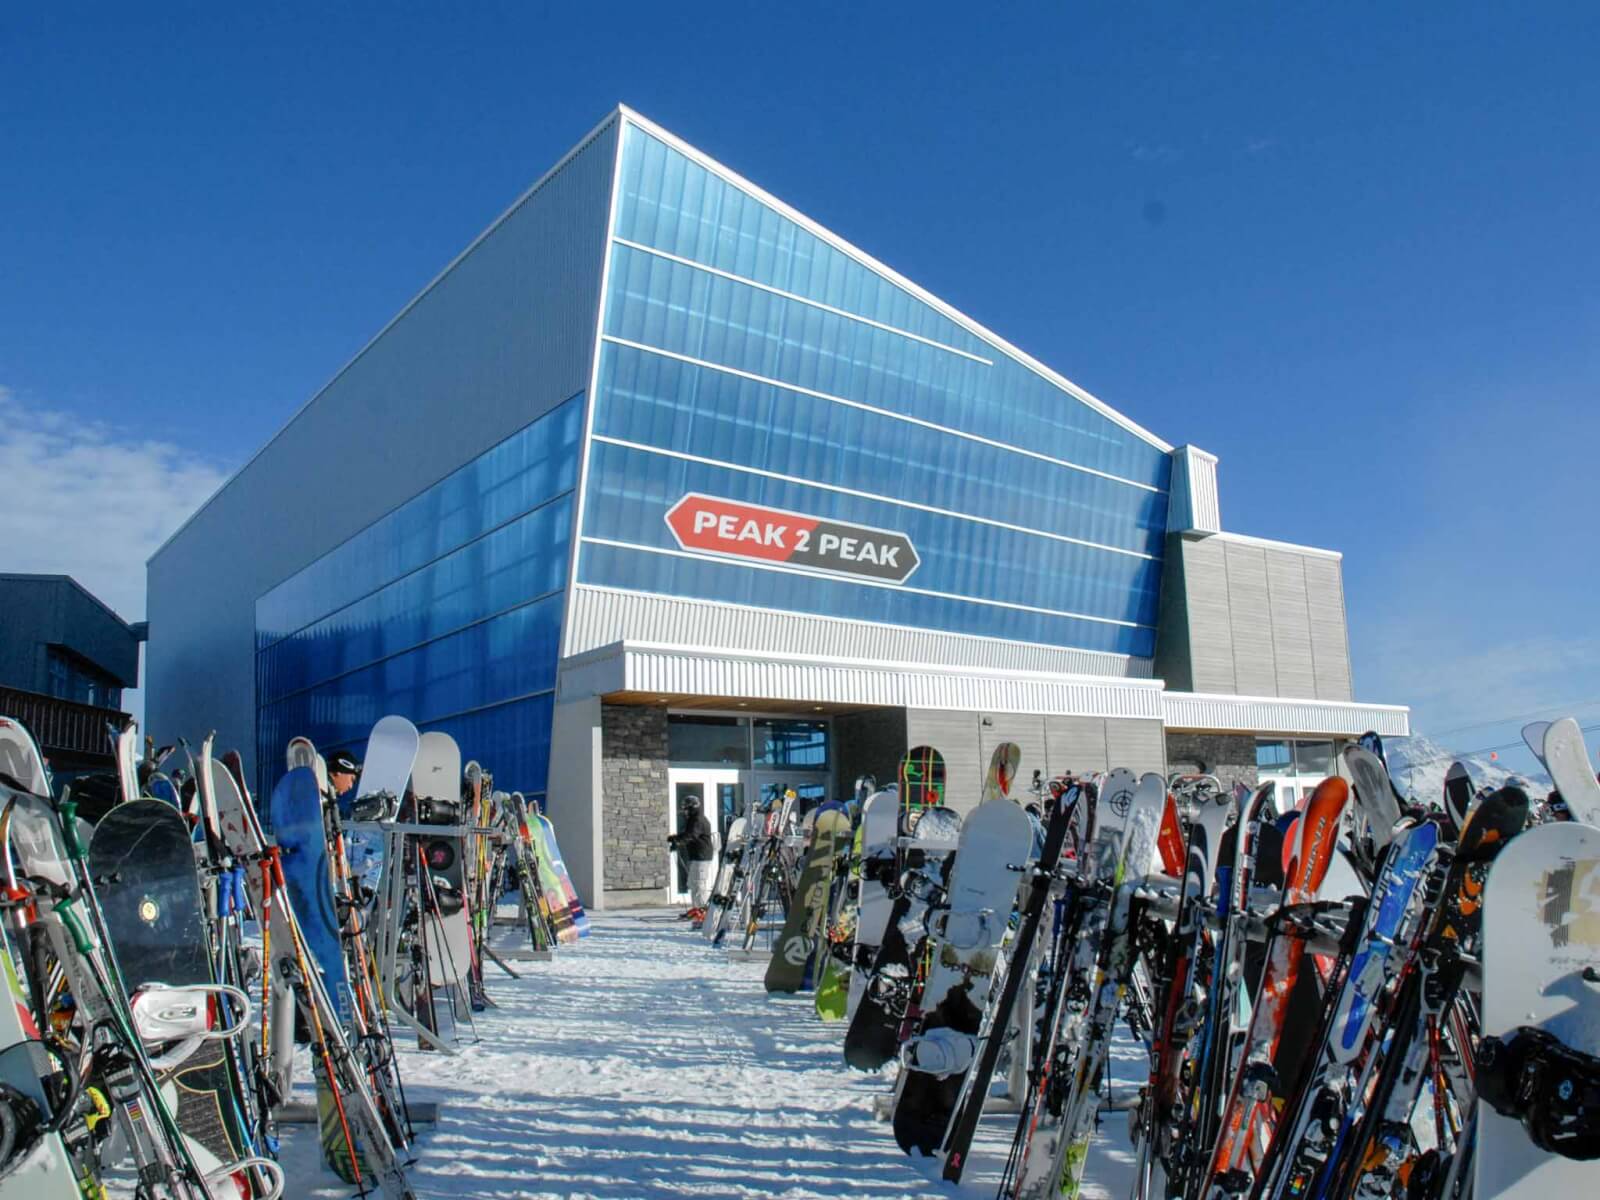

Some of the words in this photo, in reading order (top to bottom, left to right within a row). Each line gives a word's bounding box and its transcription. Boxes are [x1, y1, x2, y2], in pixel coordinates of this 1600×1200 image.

[693, 510, 788, 549] PEAK
[794, 529, 810, 553] 2
[818, 533, 900, 568] PEAK
